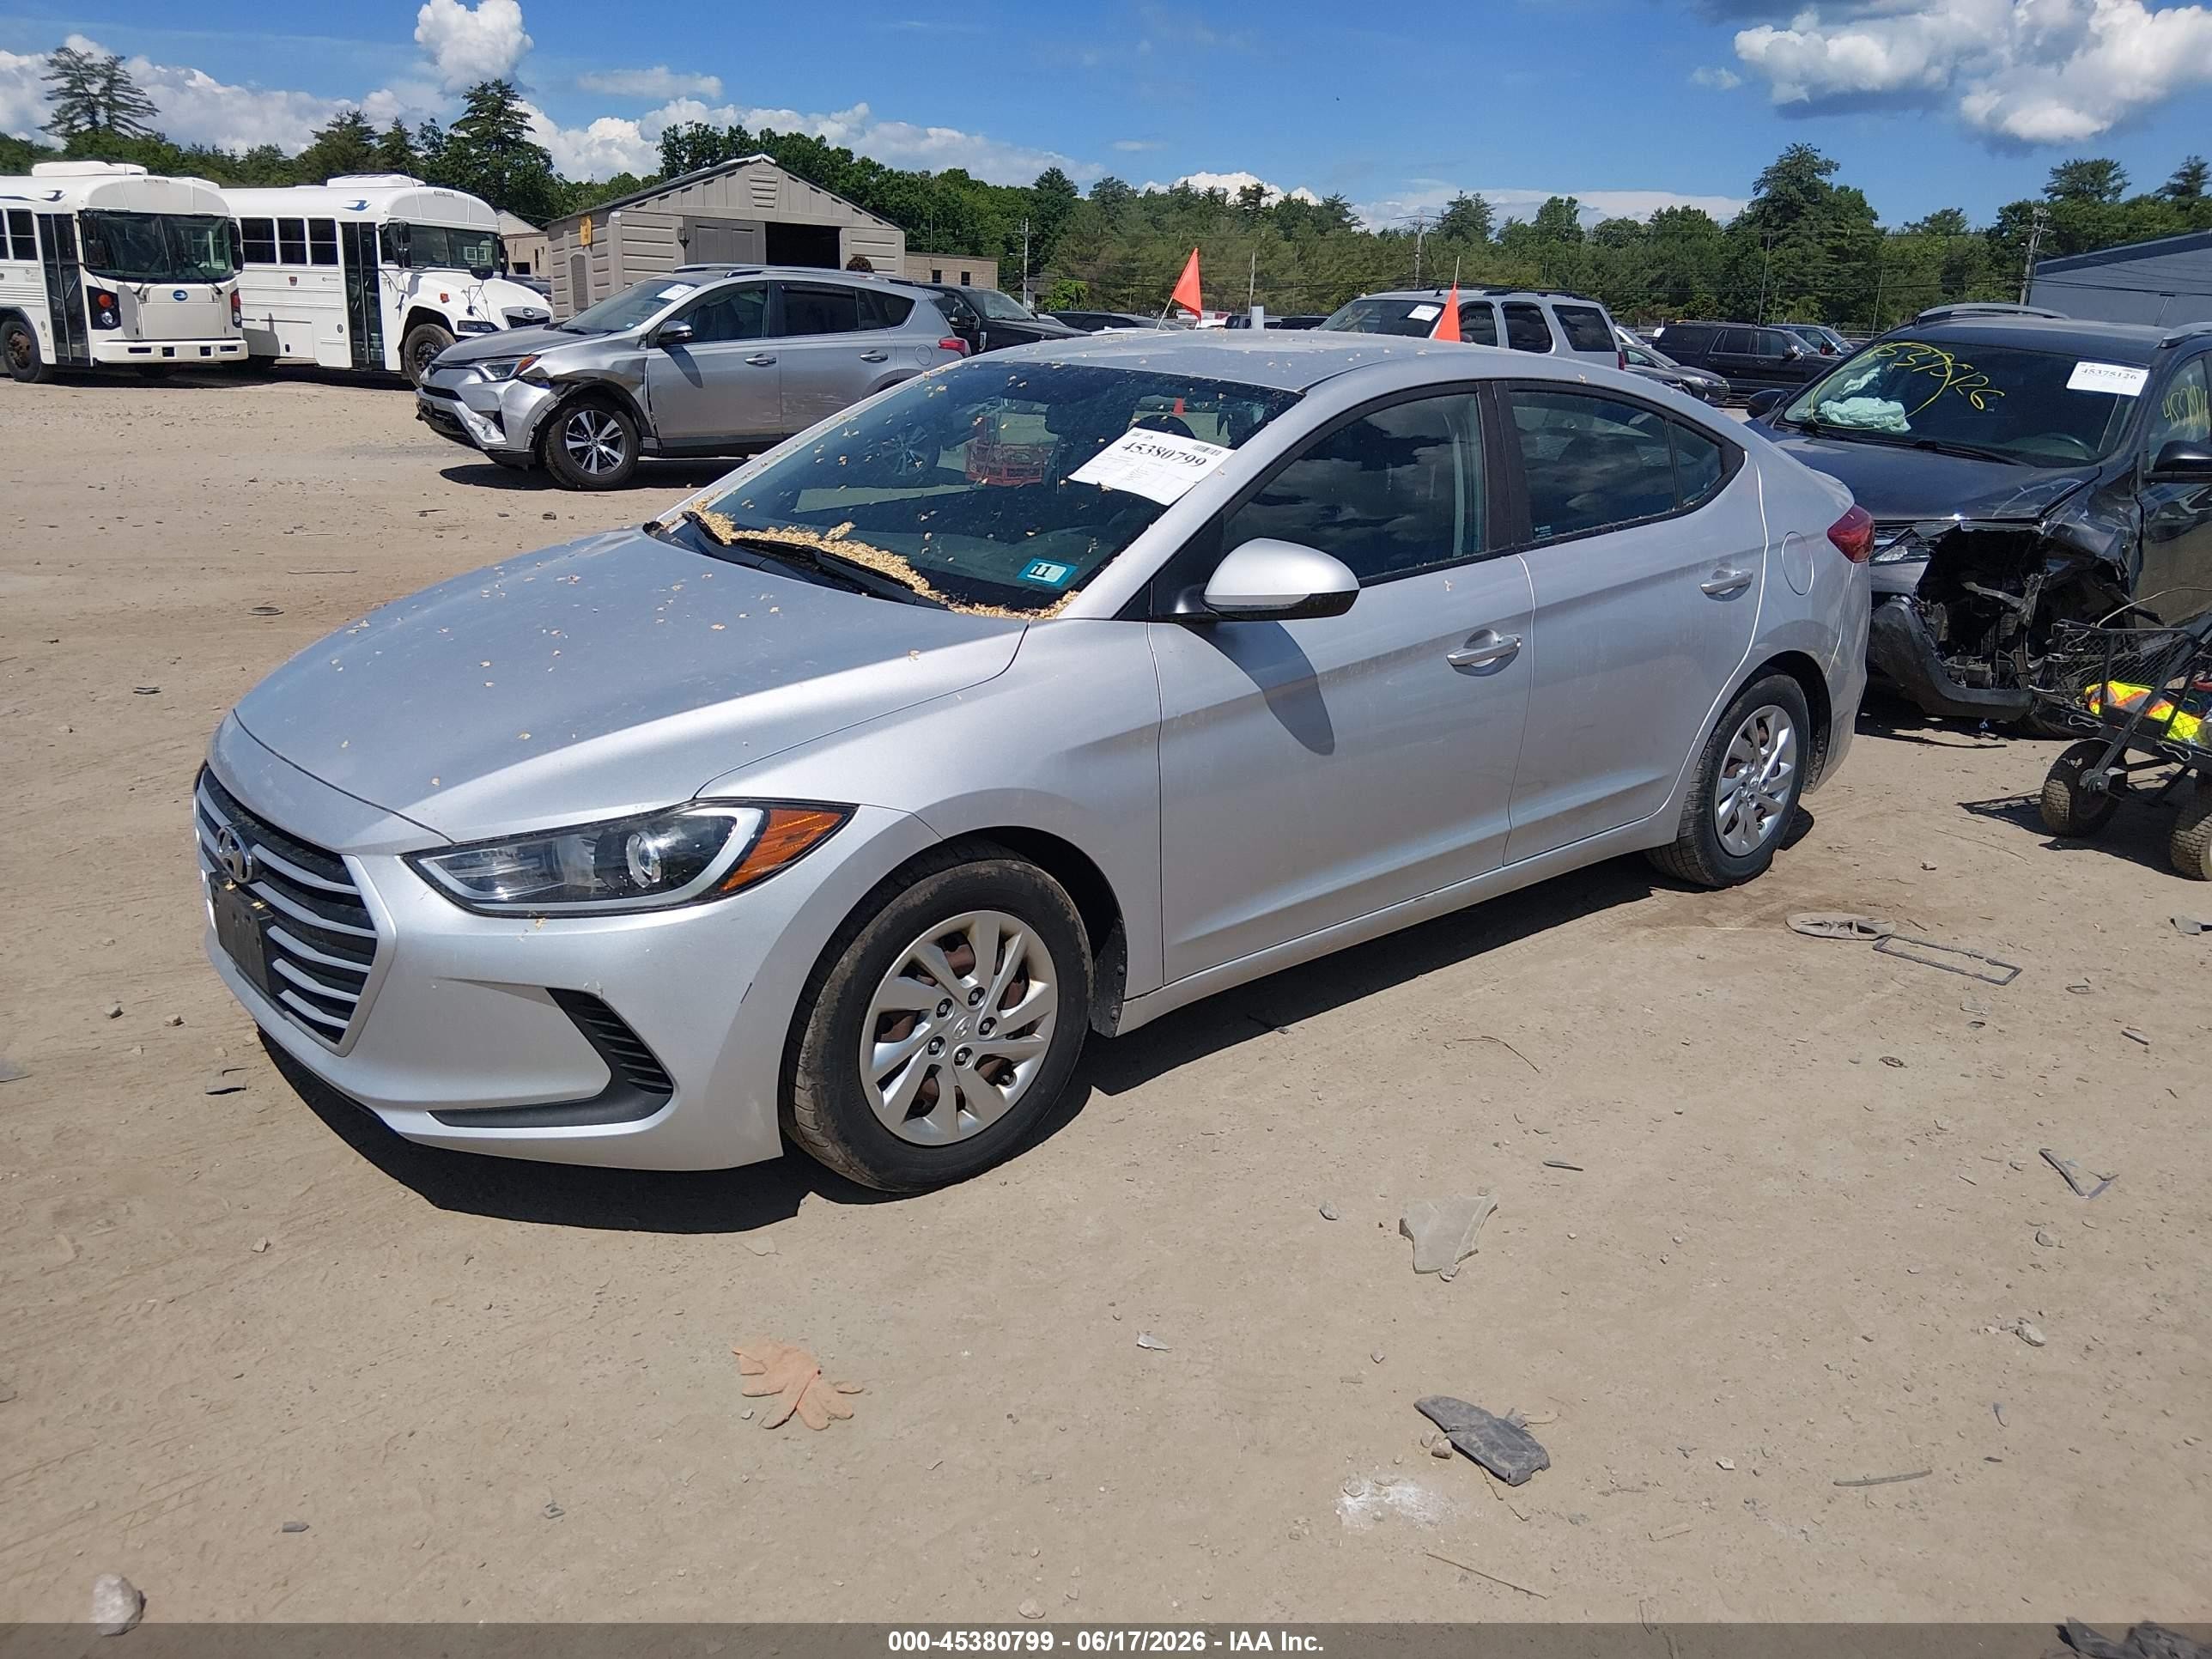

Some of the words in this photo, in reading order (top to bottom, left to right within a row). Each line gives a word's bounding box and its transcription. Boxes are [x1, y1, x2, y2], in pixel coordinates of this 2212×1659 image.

[2081, 368, 2137, 380] 45375126
[1121, 441, 1207, 467] 45380799
[1029, 563, 1052, 578] 11
